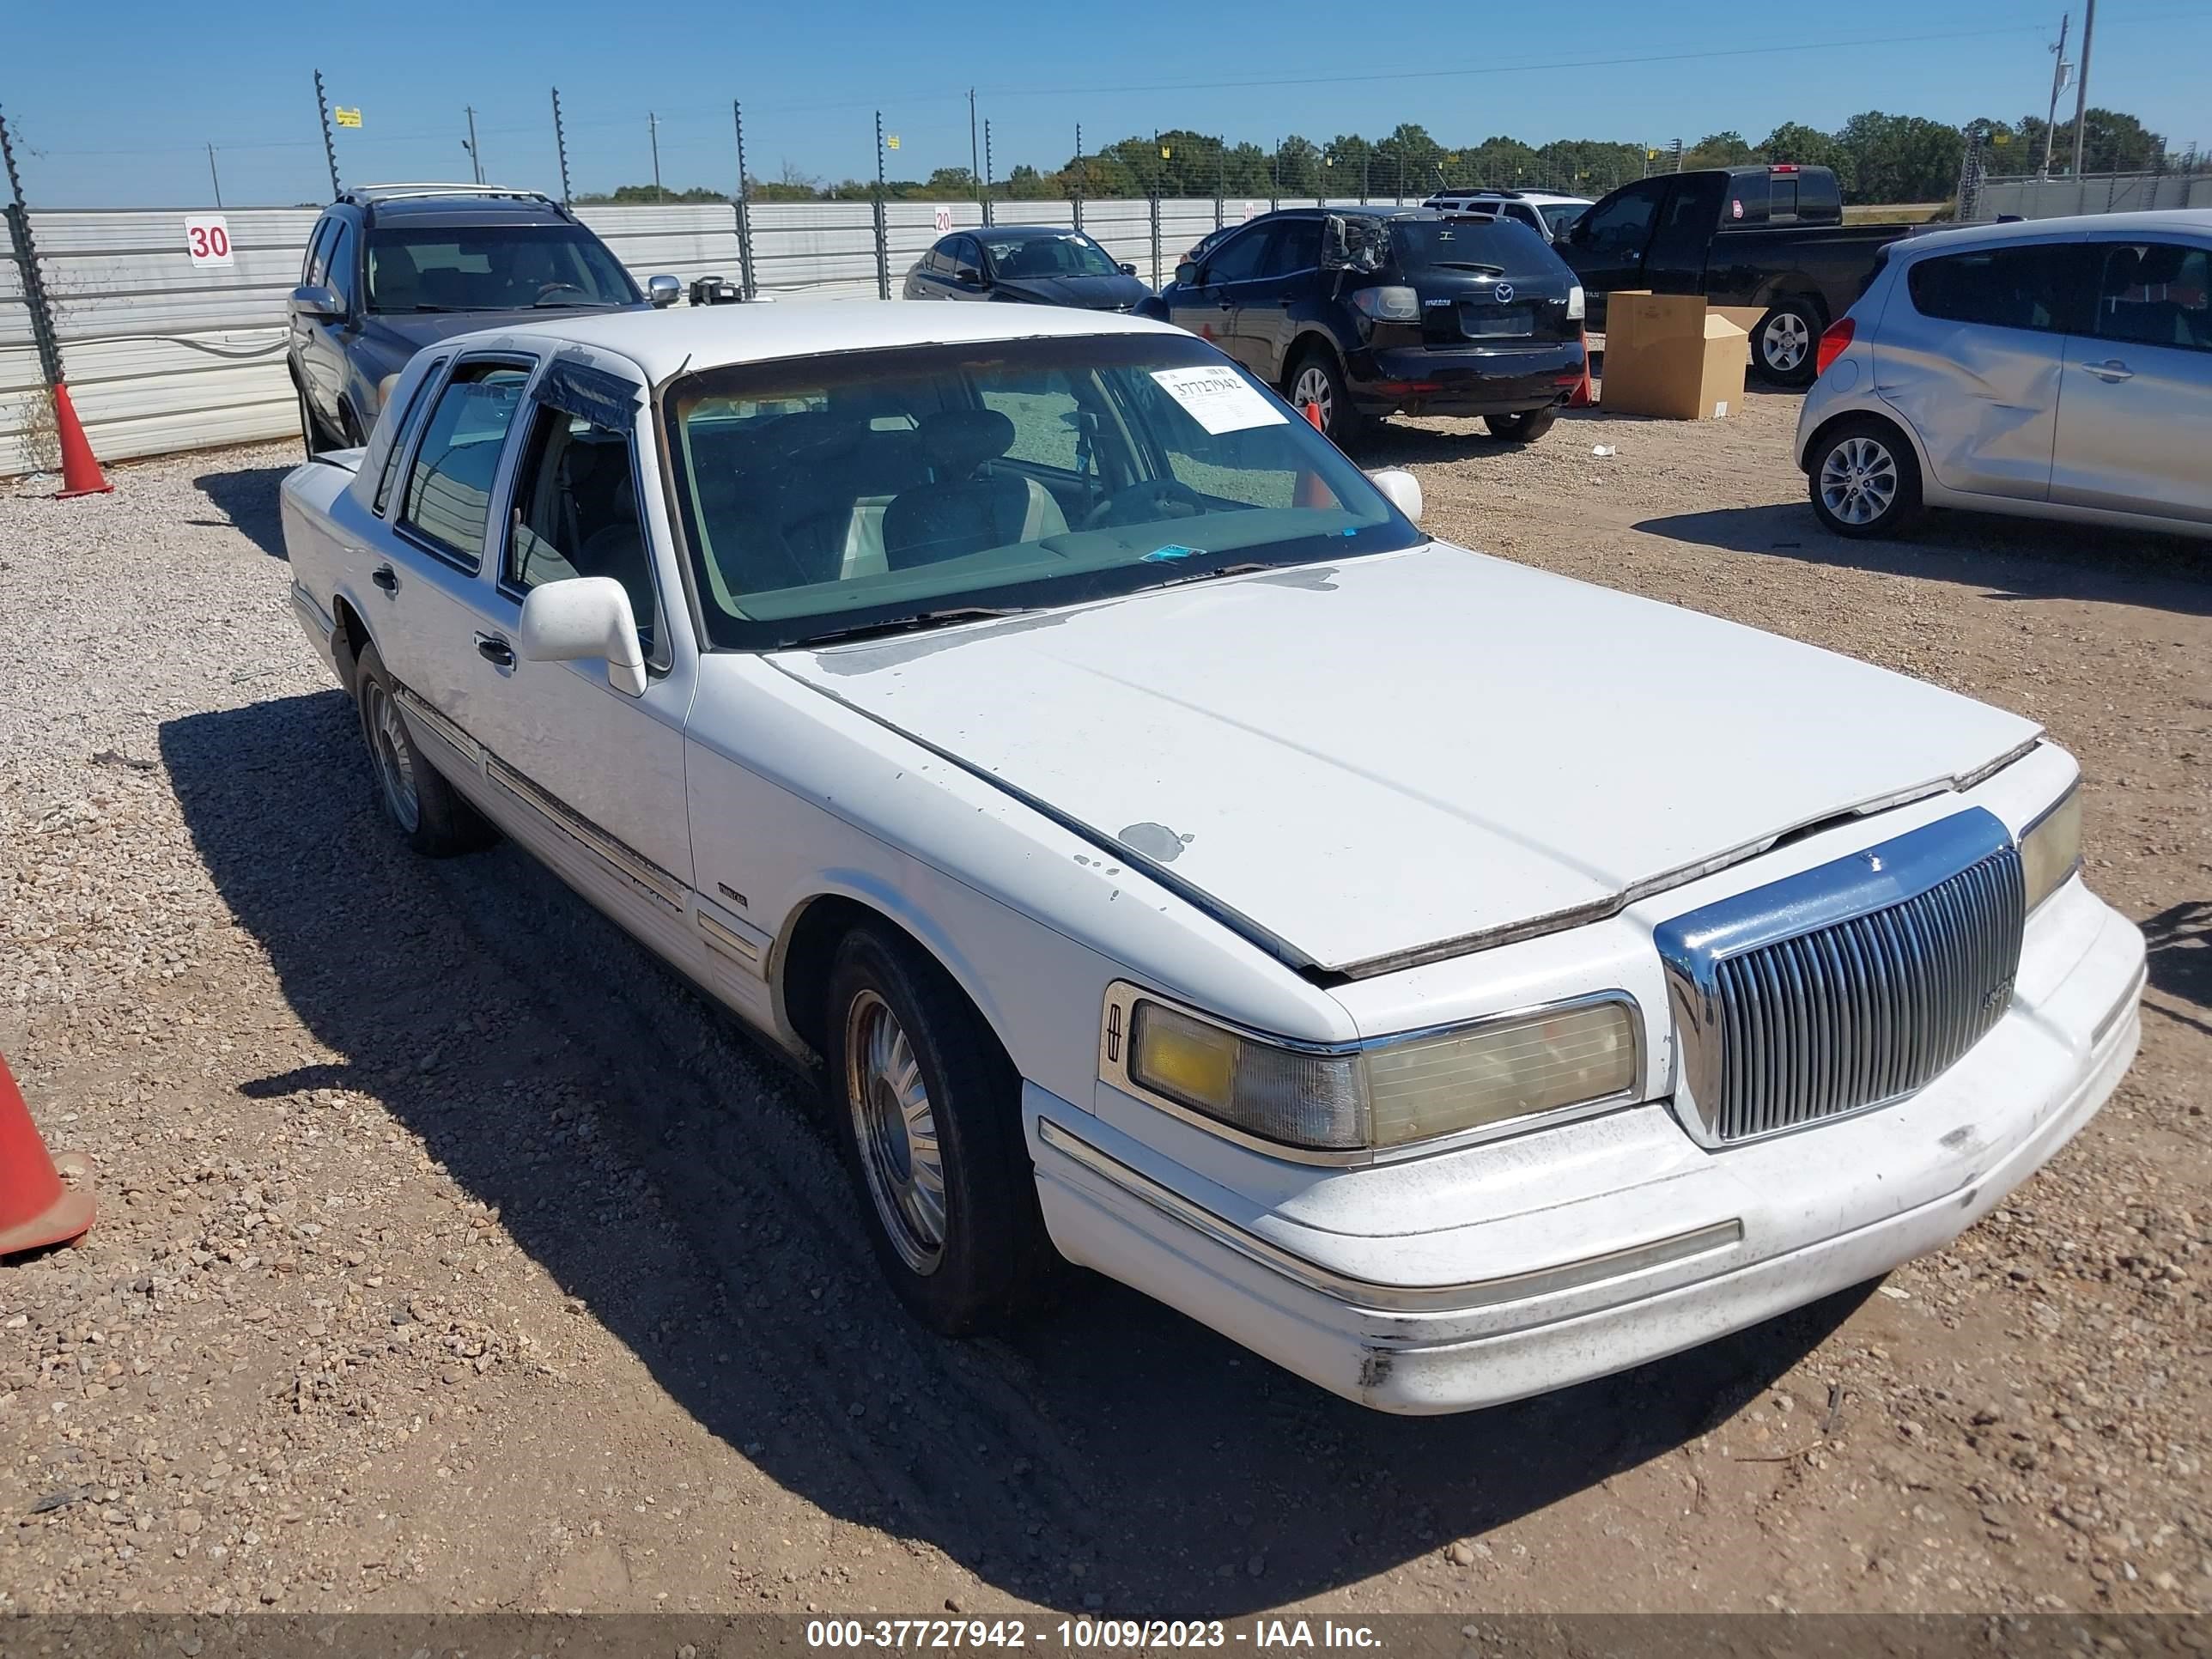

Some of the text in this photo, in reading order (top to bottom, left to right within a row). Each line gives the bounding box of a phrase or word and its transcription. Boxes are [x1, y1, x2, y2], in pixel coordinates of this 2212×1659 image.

[937, 212, 950, 231] 20
[190, 227, 228, 257] 30
[1173, 378, 1242, 396] 37727942
